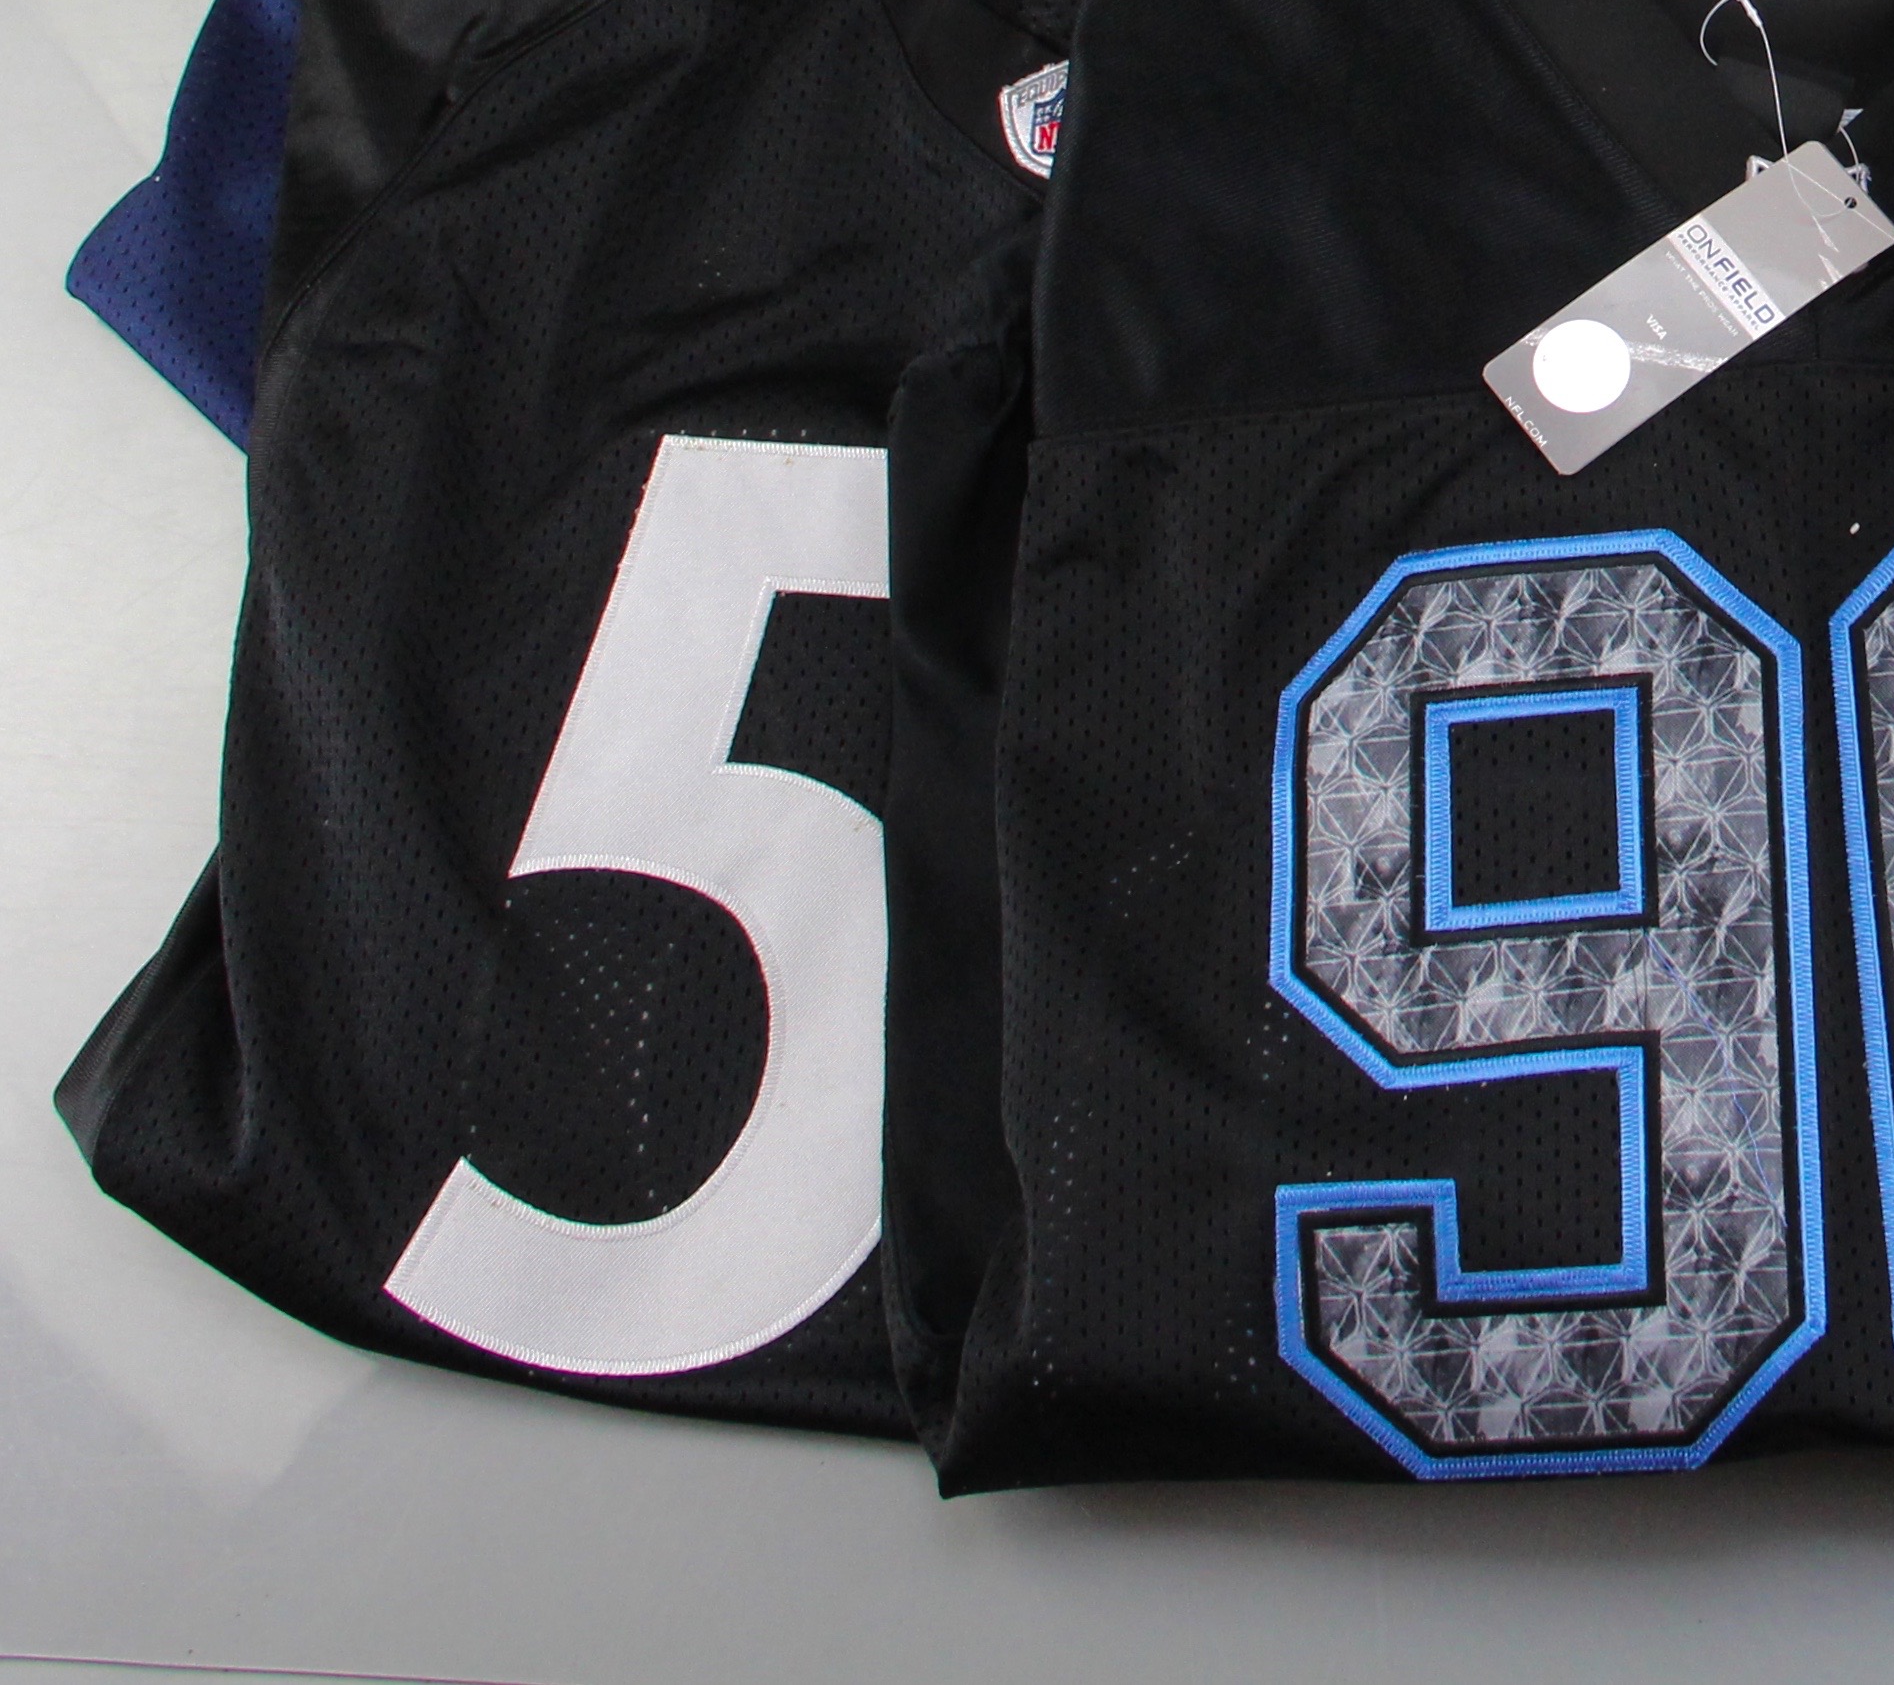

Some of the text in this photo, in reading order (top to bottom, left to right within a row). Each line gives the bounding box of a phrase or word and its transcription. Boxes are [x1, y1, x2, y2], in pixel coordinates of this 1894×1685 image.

[1677, 233, 1761, 332] PERFORMANCE APPAREL
[1684, 273, 1700, 291] THE
[1686, 223, 1776, 325] ONFIELD
[1646, 314, 1668, 342] VISA
[1503, 395, 1548, 448] NFL.COM
[383, 434, 891, 1377] 5
